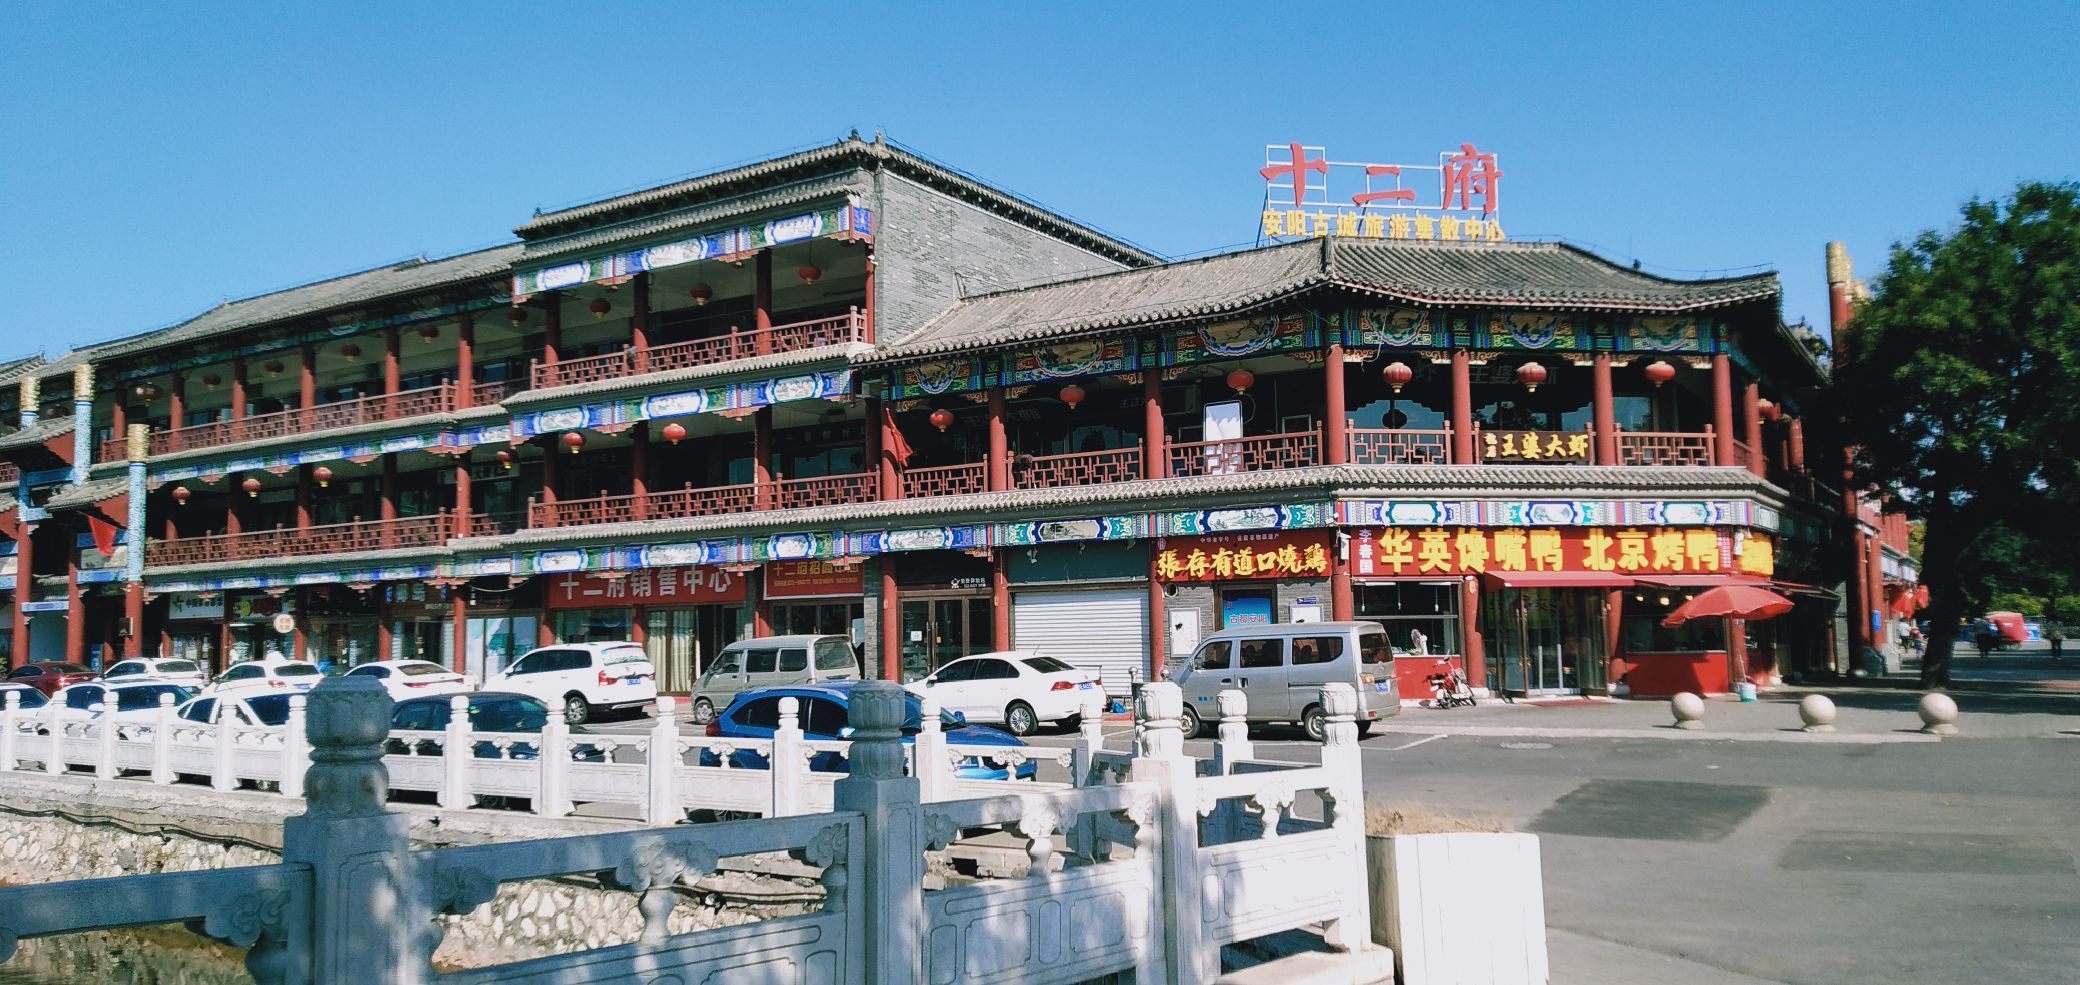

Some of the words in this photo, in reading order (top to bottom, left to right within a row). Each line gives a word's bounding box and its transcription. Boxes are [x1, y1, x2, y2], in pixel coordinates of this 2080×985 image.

[1260, 141, 1503, 215] 十二府
[1262, 208, 1505, 241] 安阳古城旅游集散中心
[1501, 431, 1589, 459] 王婆大虾
[1379, 527, 1563, 575] 华英馋嘴鸭
[1582, 527, 1720, 573] 北京烤鸭
[560, 564, 732, 600] 十二府销售中心
